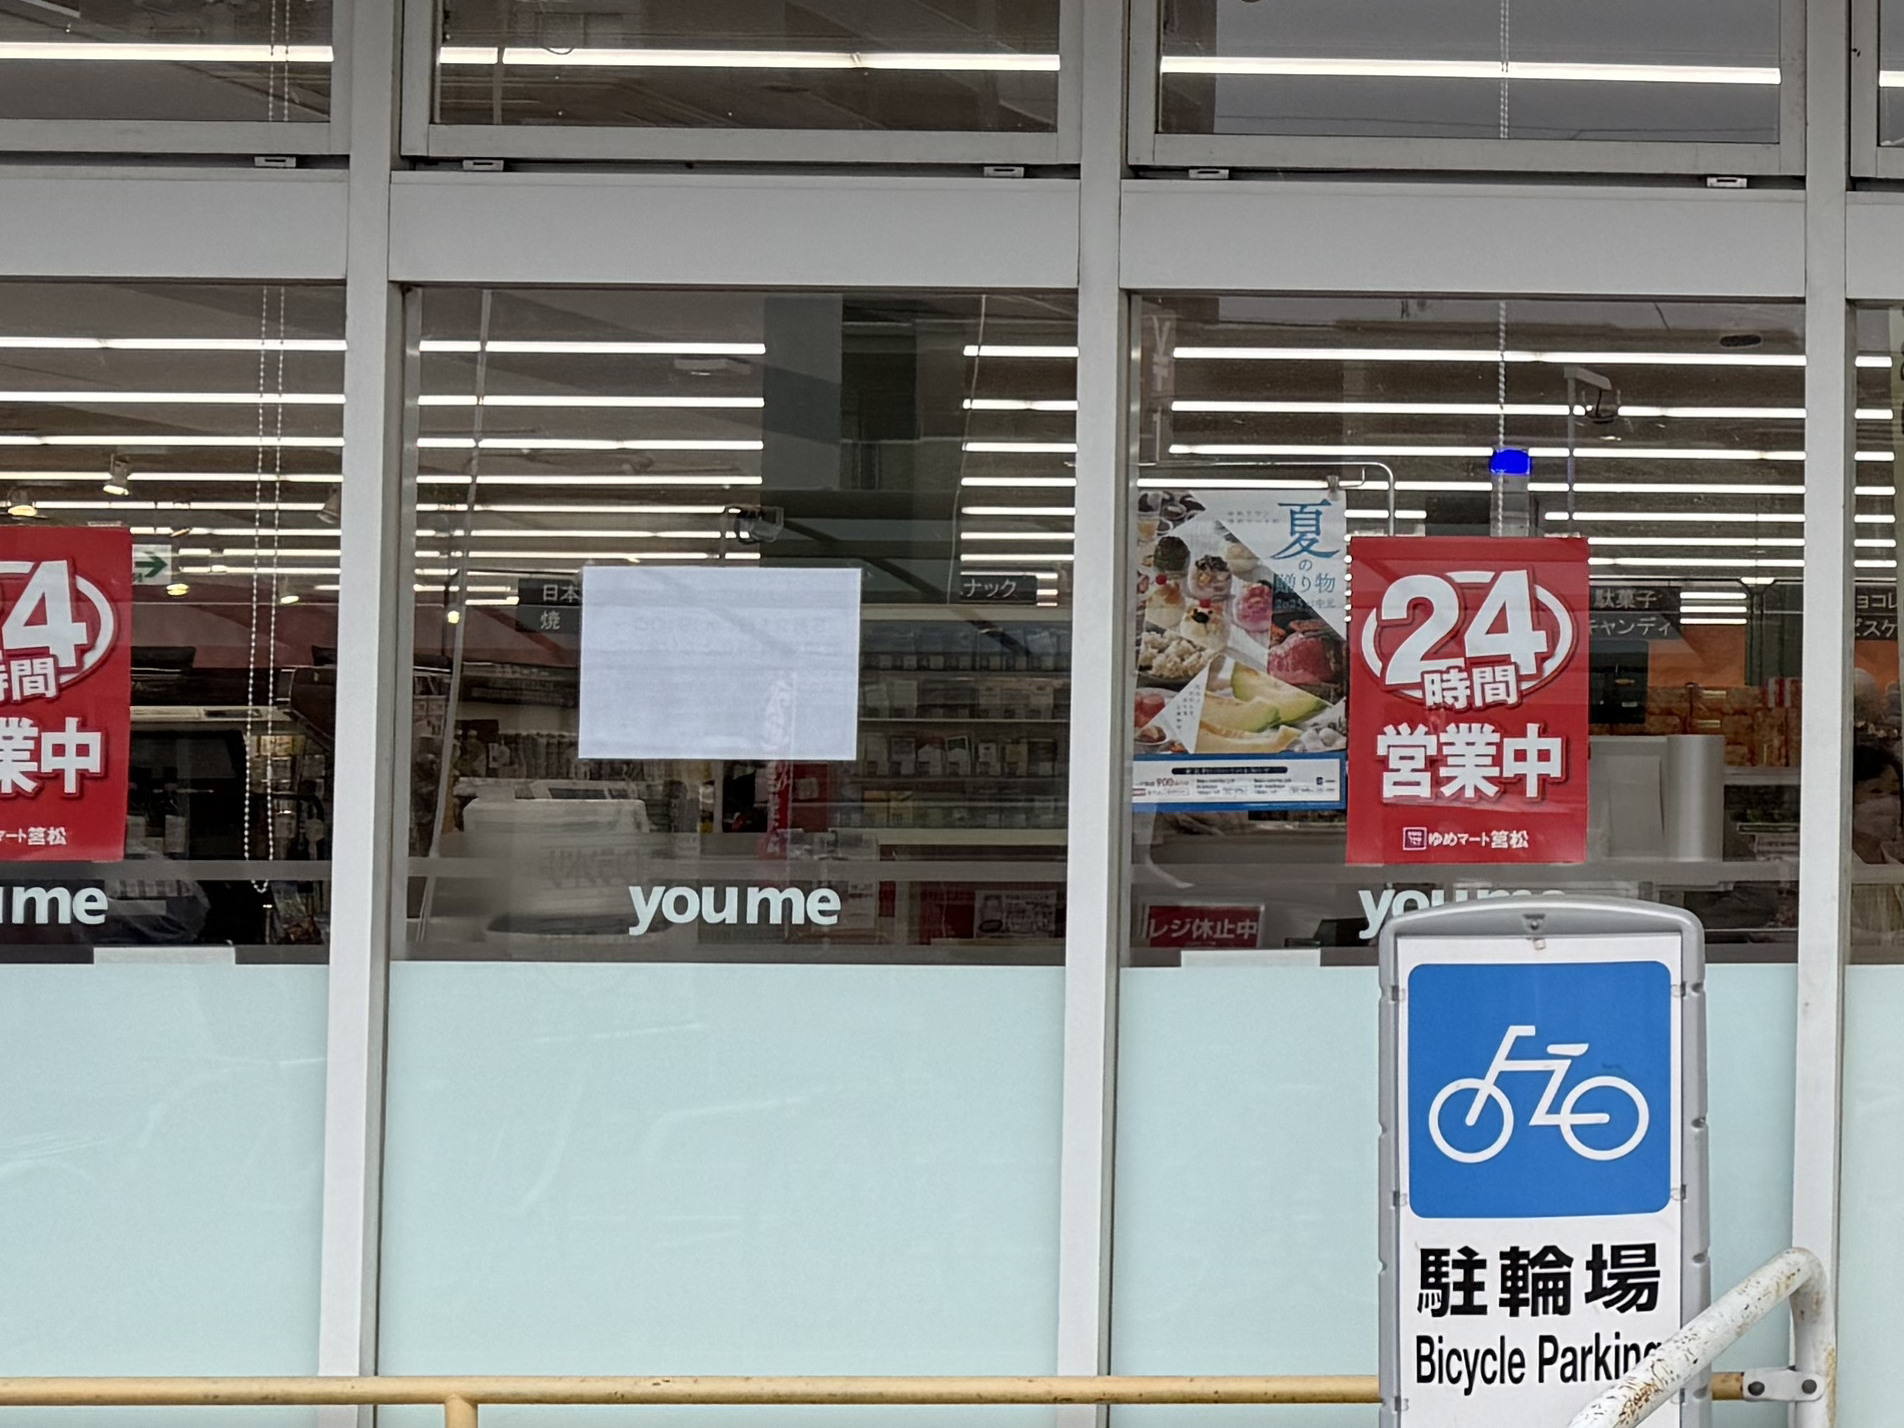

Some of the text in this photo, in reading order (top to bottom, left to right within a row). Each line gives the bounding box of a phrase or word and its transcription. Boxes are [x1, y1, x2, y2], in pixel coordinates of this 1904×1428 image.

[1271, 499, 1340, 560] 夏
[960, 578, 1017, 598] ナック
[1299, 559, 1312, 571] の
[1381, 570, 1547, 684] 24
[0, 657, 57, 701] 間
[1424, 665, 1518, 710] 時間
[1377, 722, 1562, 798] 営業中
[0, 885, 109, 925] me
[628, 885, 842, 936] youme
[1149, 916, 1260, 941] レジ休止中
[1417, 1242, 1661, 1318] 駐輪場
[1416, 1331, 1662, 1396] Bicycle Parkin
